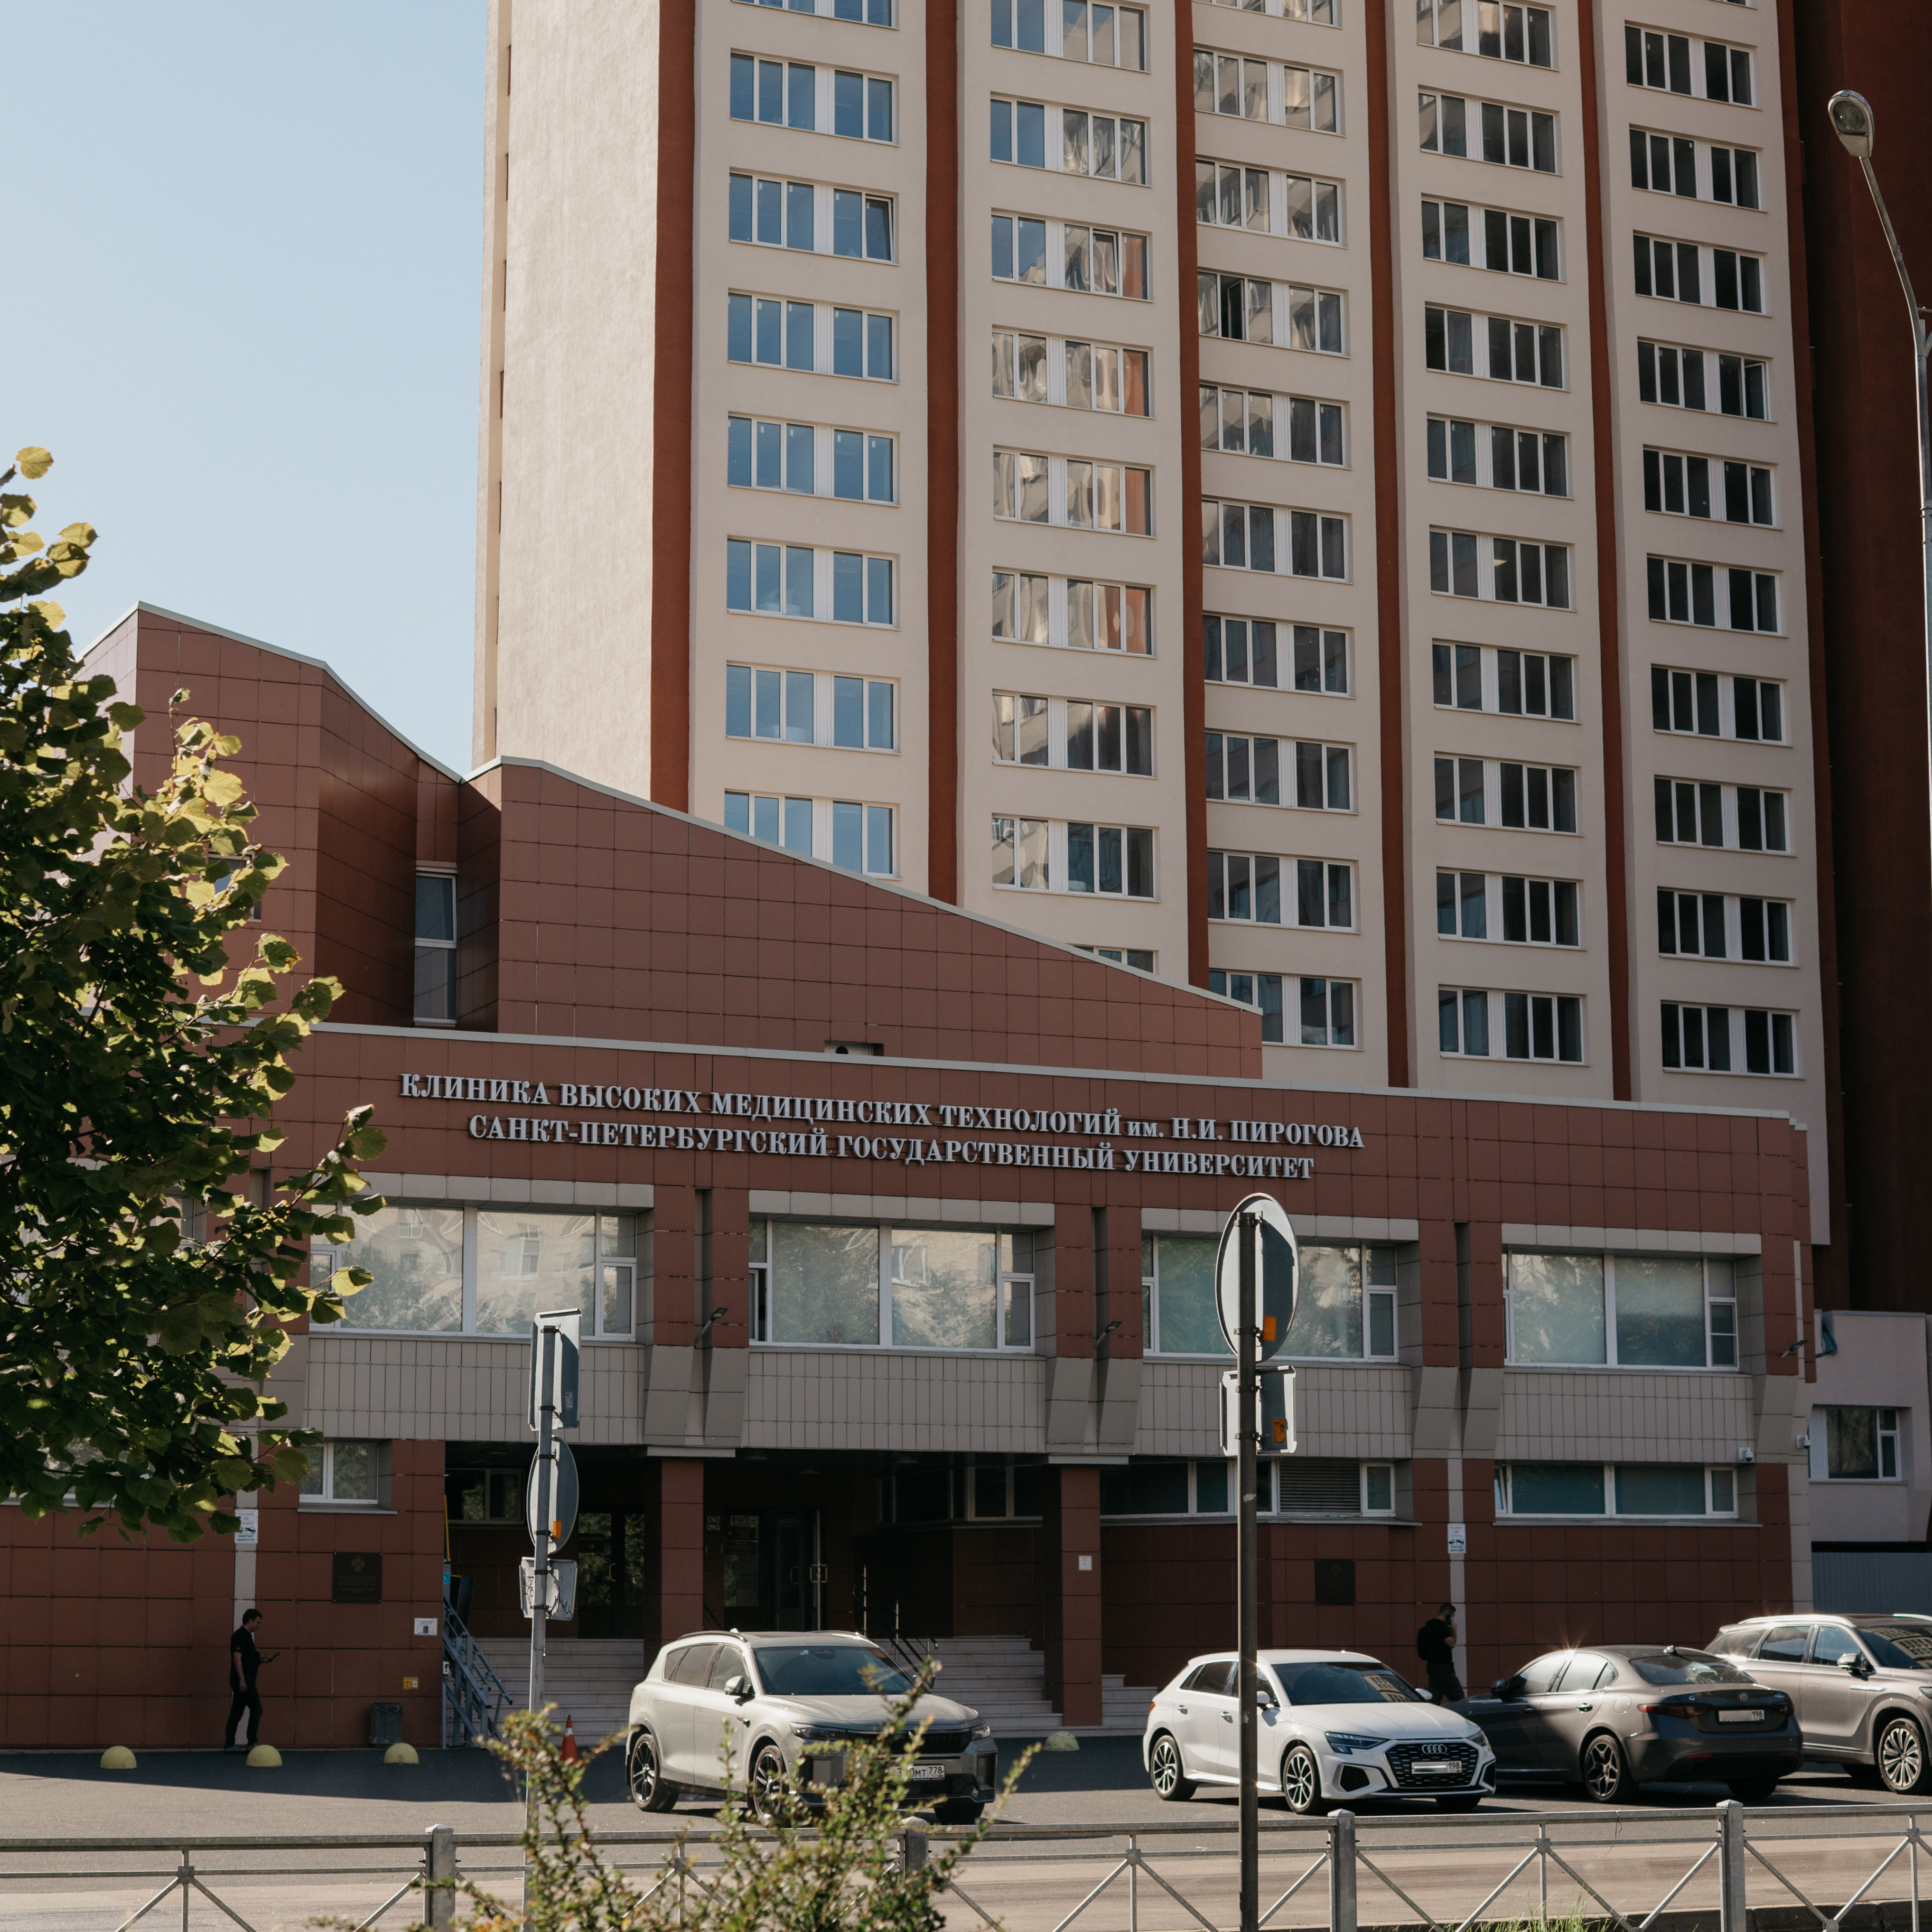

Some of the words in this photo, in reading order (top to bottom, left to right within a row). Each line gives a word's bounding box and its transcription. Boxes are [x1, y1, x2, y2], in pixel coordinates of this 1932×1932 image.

[400, 1073, 551, 1105] КЛИНИКА
[559, 1083, 703, 1113] ВЫСОКИХ
[710, 1092, 933, 1126] МЕДИЦИНСКИХ
[939, 1105, 1122, 1136] ТЕХНОЛОГИЙ
[1127, 1121, 1164, 1138] им.
[1230, 1120, 1365, 1148] ПИРОГОВА
[469, 1115, 829, 1157] САНКТ-ПЕТЕРБУРГСКИЙ
[837, 1135, 1116, 1170] ГОСУДАРСТВЕННЫЙ
[1122, 1150, 1315, 1179] УНИВЕРСИТЕТ
[928, 1766, 942, 1774] 778
[1448, 1762, 1460, 1770] 198
